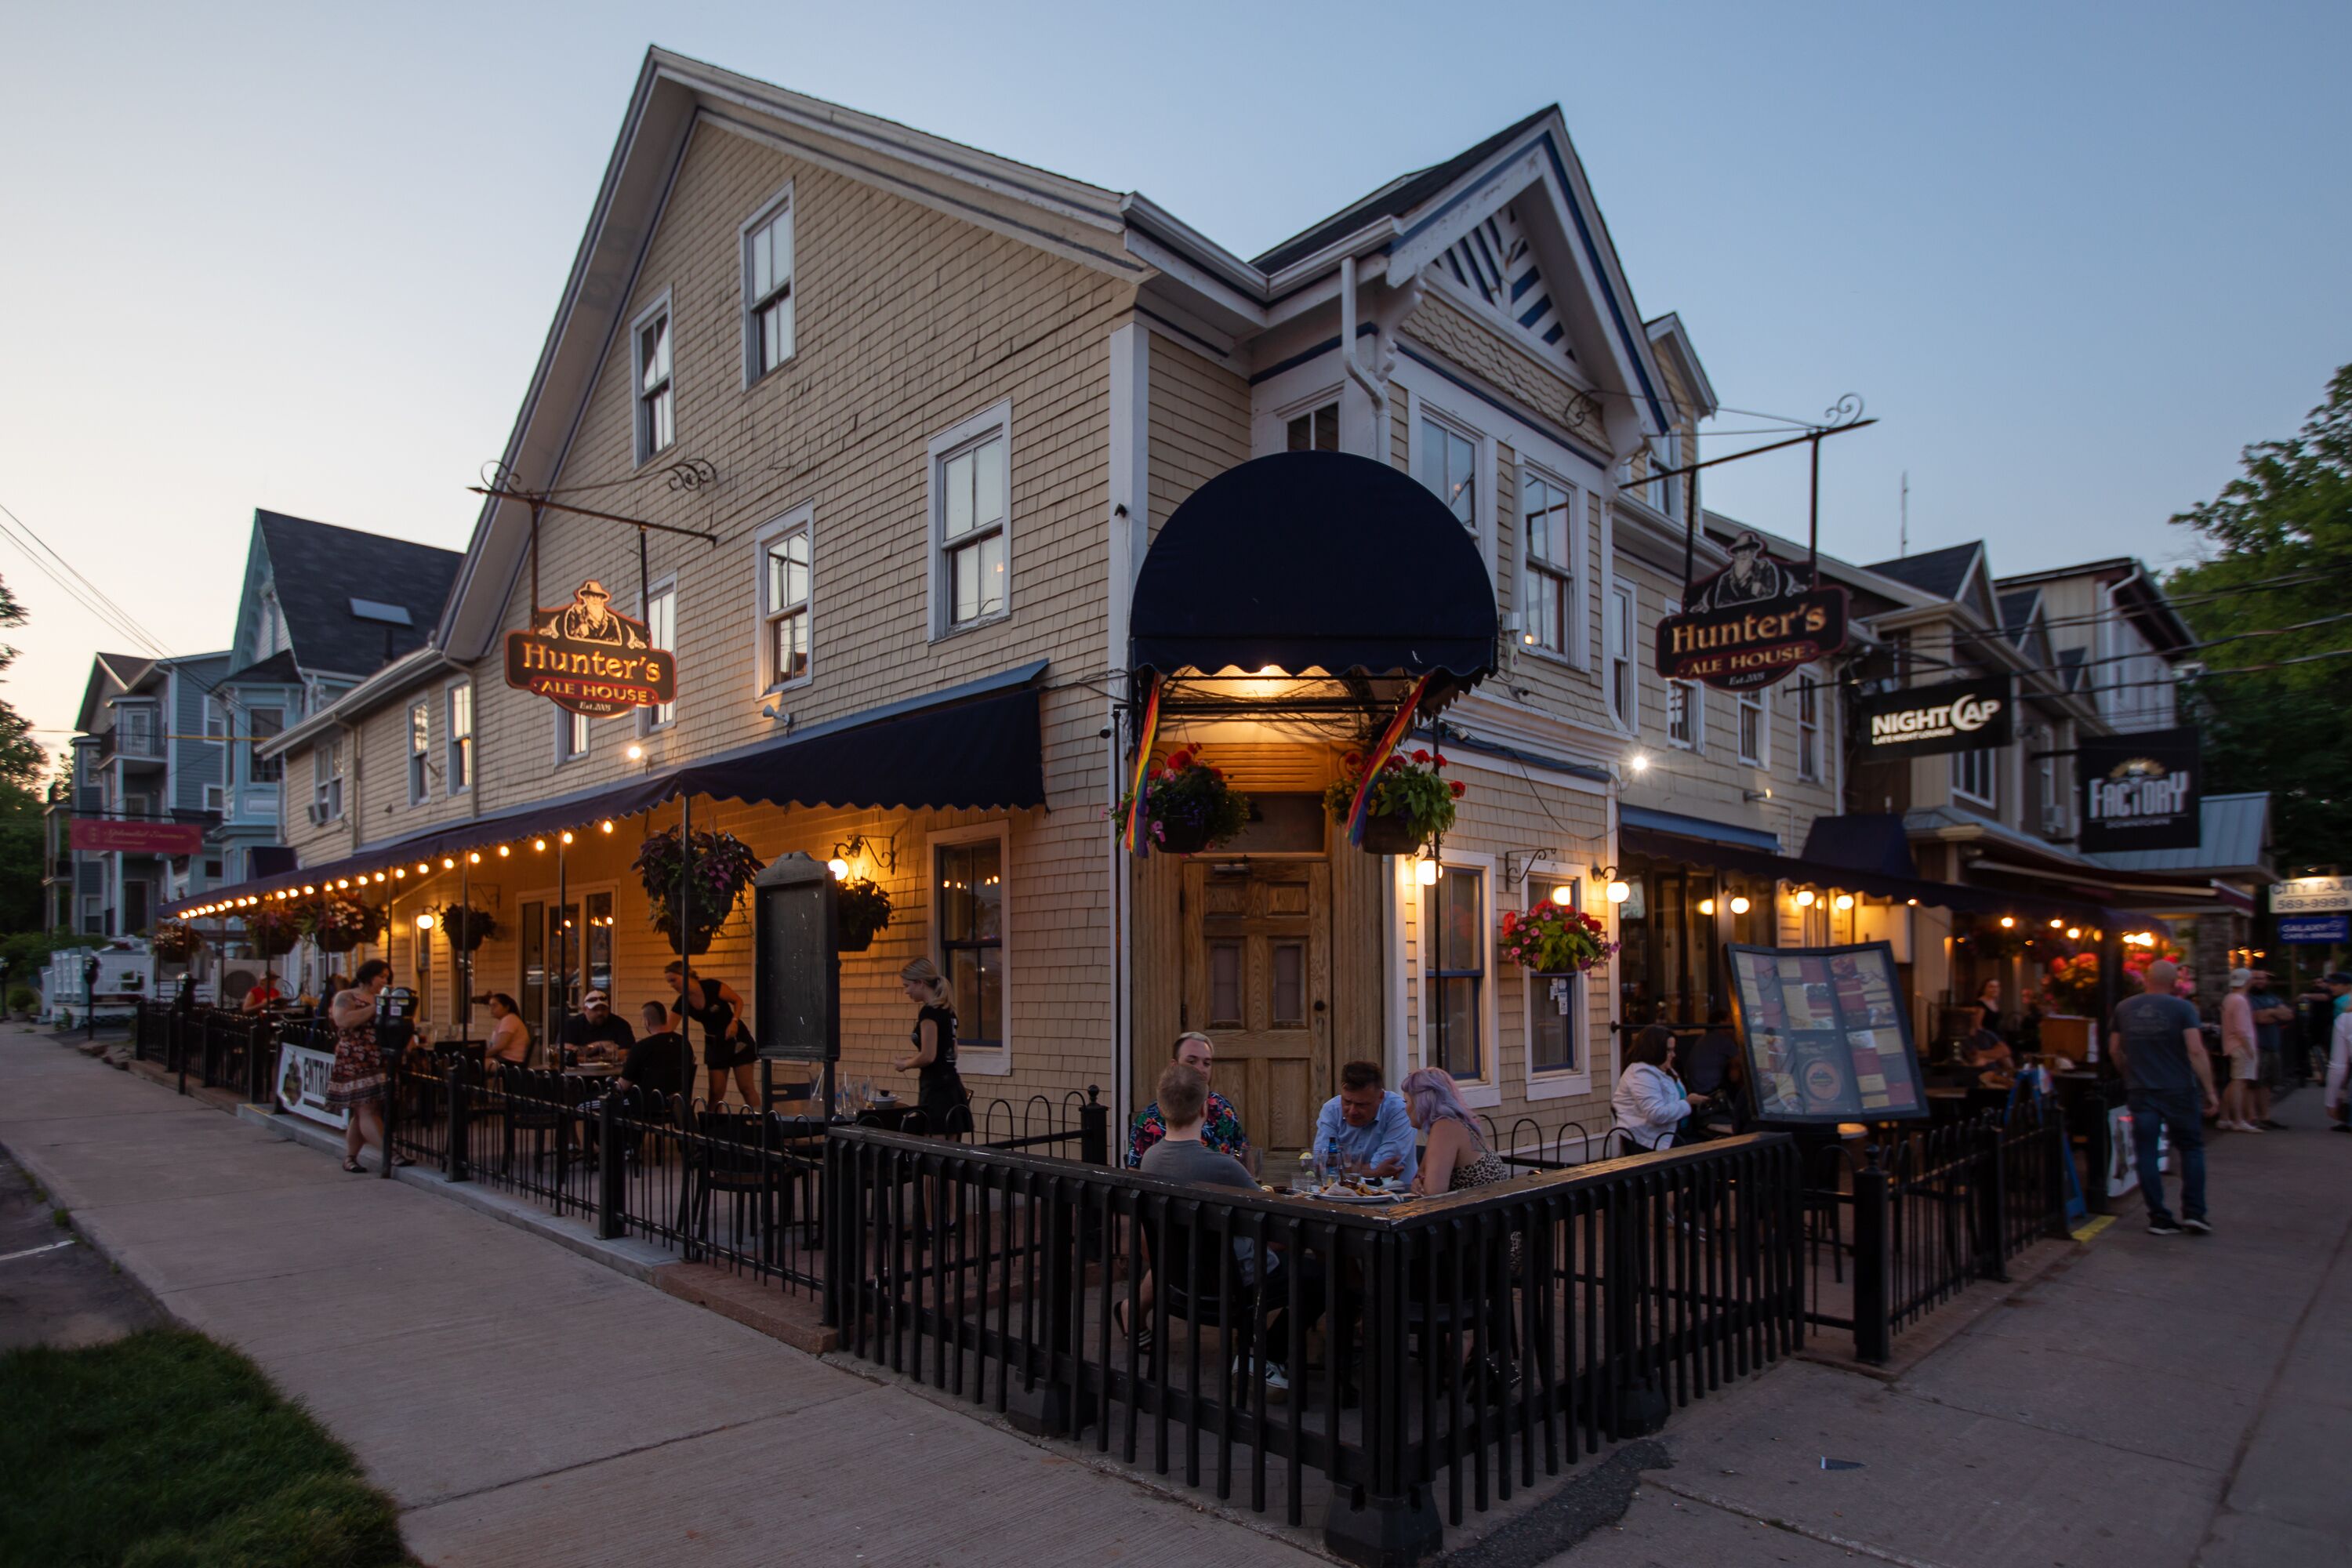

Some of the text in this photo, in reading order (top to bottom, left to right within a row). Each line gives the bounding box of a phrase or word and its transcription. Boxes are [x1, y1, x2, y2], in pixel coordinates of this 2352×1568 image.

[1671, 603, 1827, 653] Hunter's
[523, 643, 661, 682] Hunter's
[1689, 645, 1806, 676] ALE HOUSE
[541, 680, 648, 703] ALE HOUSE
[1918, 726, 1955, 740] LOUNGE
[2089, 770, 2189, 818] FACTORY
[2271, 882, 2308, 895] CITY
